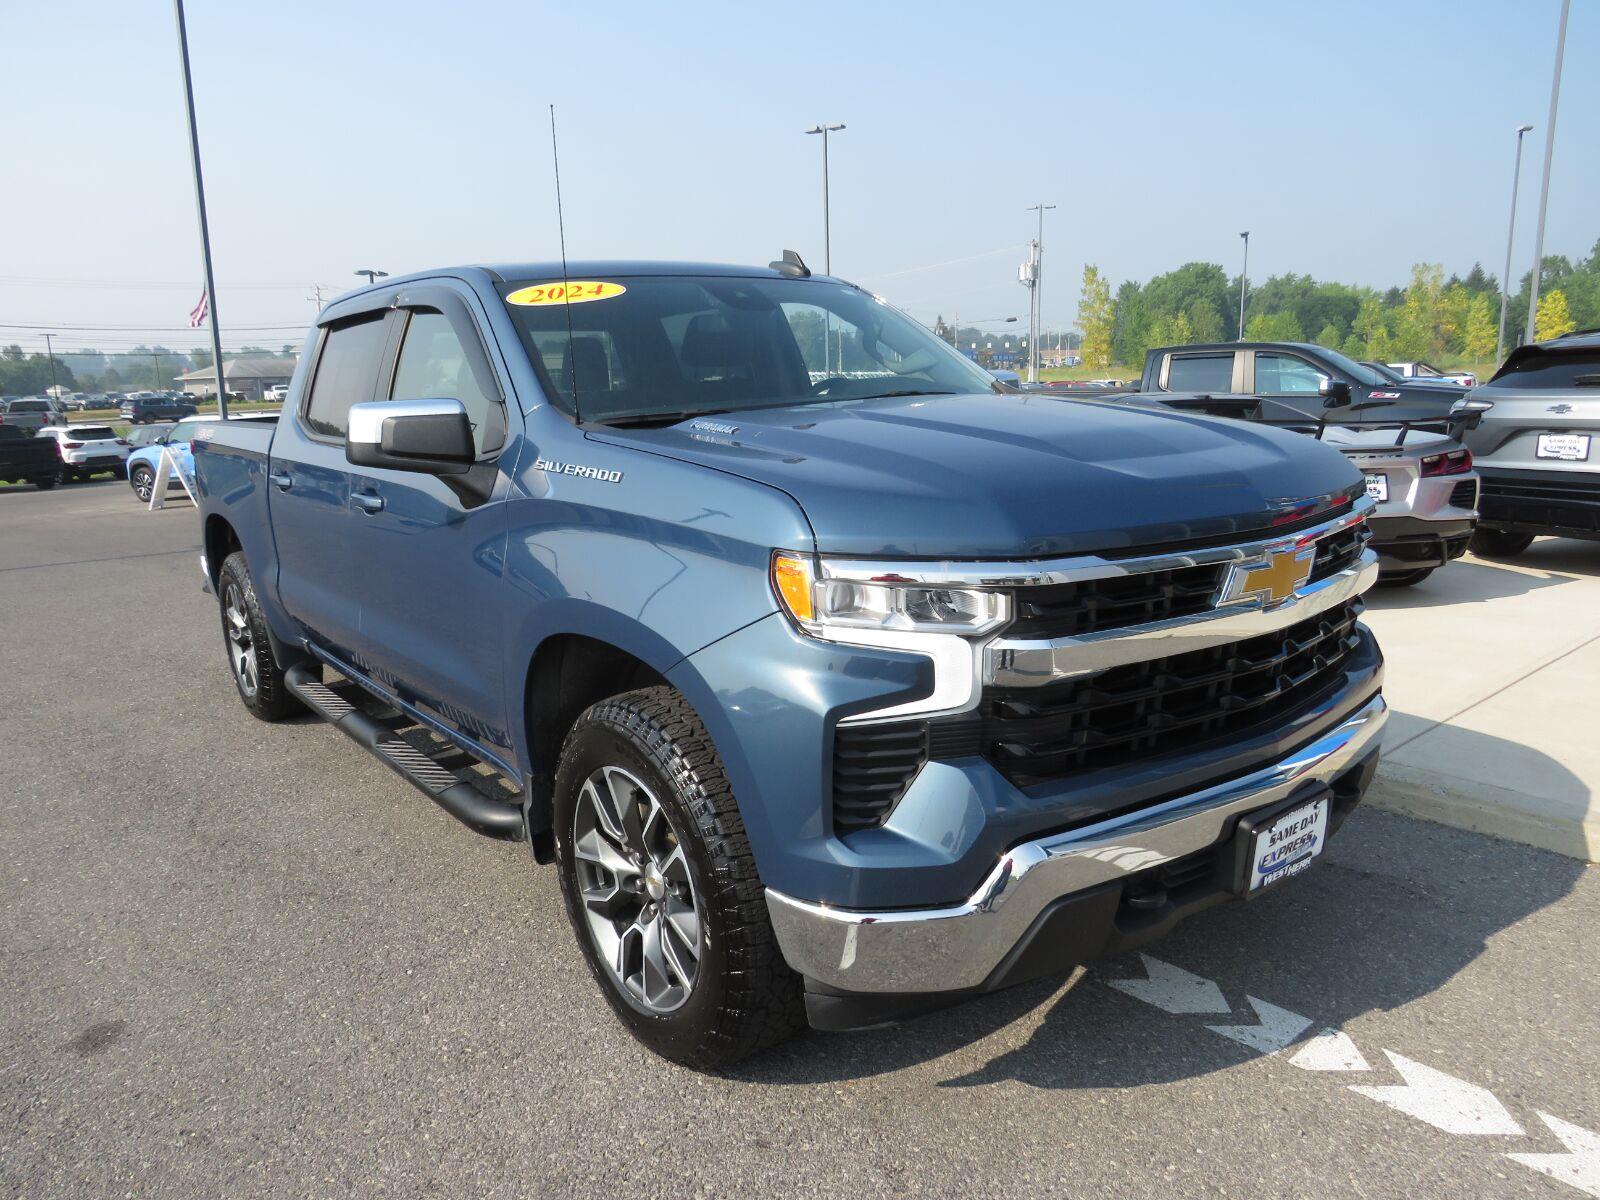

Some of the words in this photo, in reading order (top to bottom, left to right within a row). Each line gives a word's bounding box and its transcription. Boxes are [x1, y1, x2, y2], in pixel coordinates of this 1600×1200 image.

[528, 284, 603, 303] 2024
[533, 458, 624, 483] SILVERADO
[1268, 821, 1299, 848] SAME
[1300, 810, 1320, 831] DAY
[1262, 831, 1314, 867] EXPRESS
